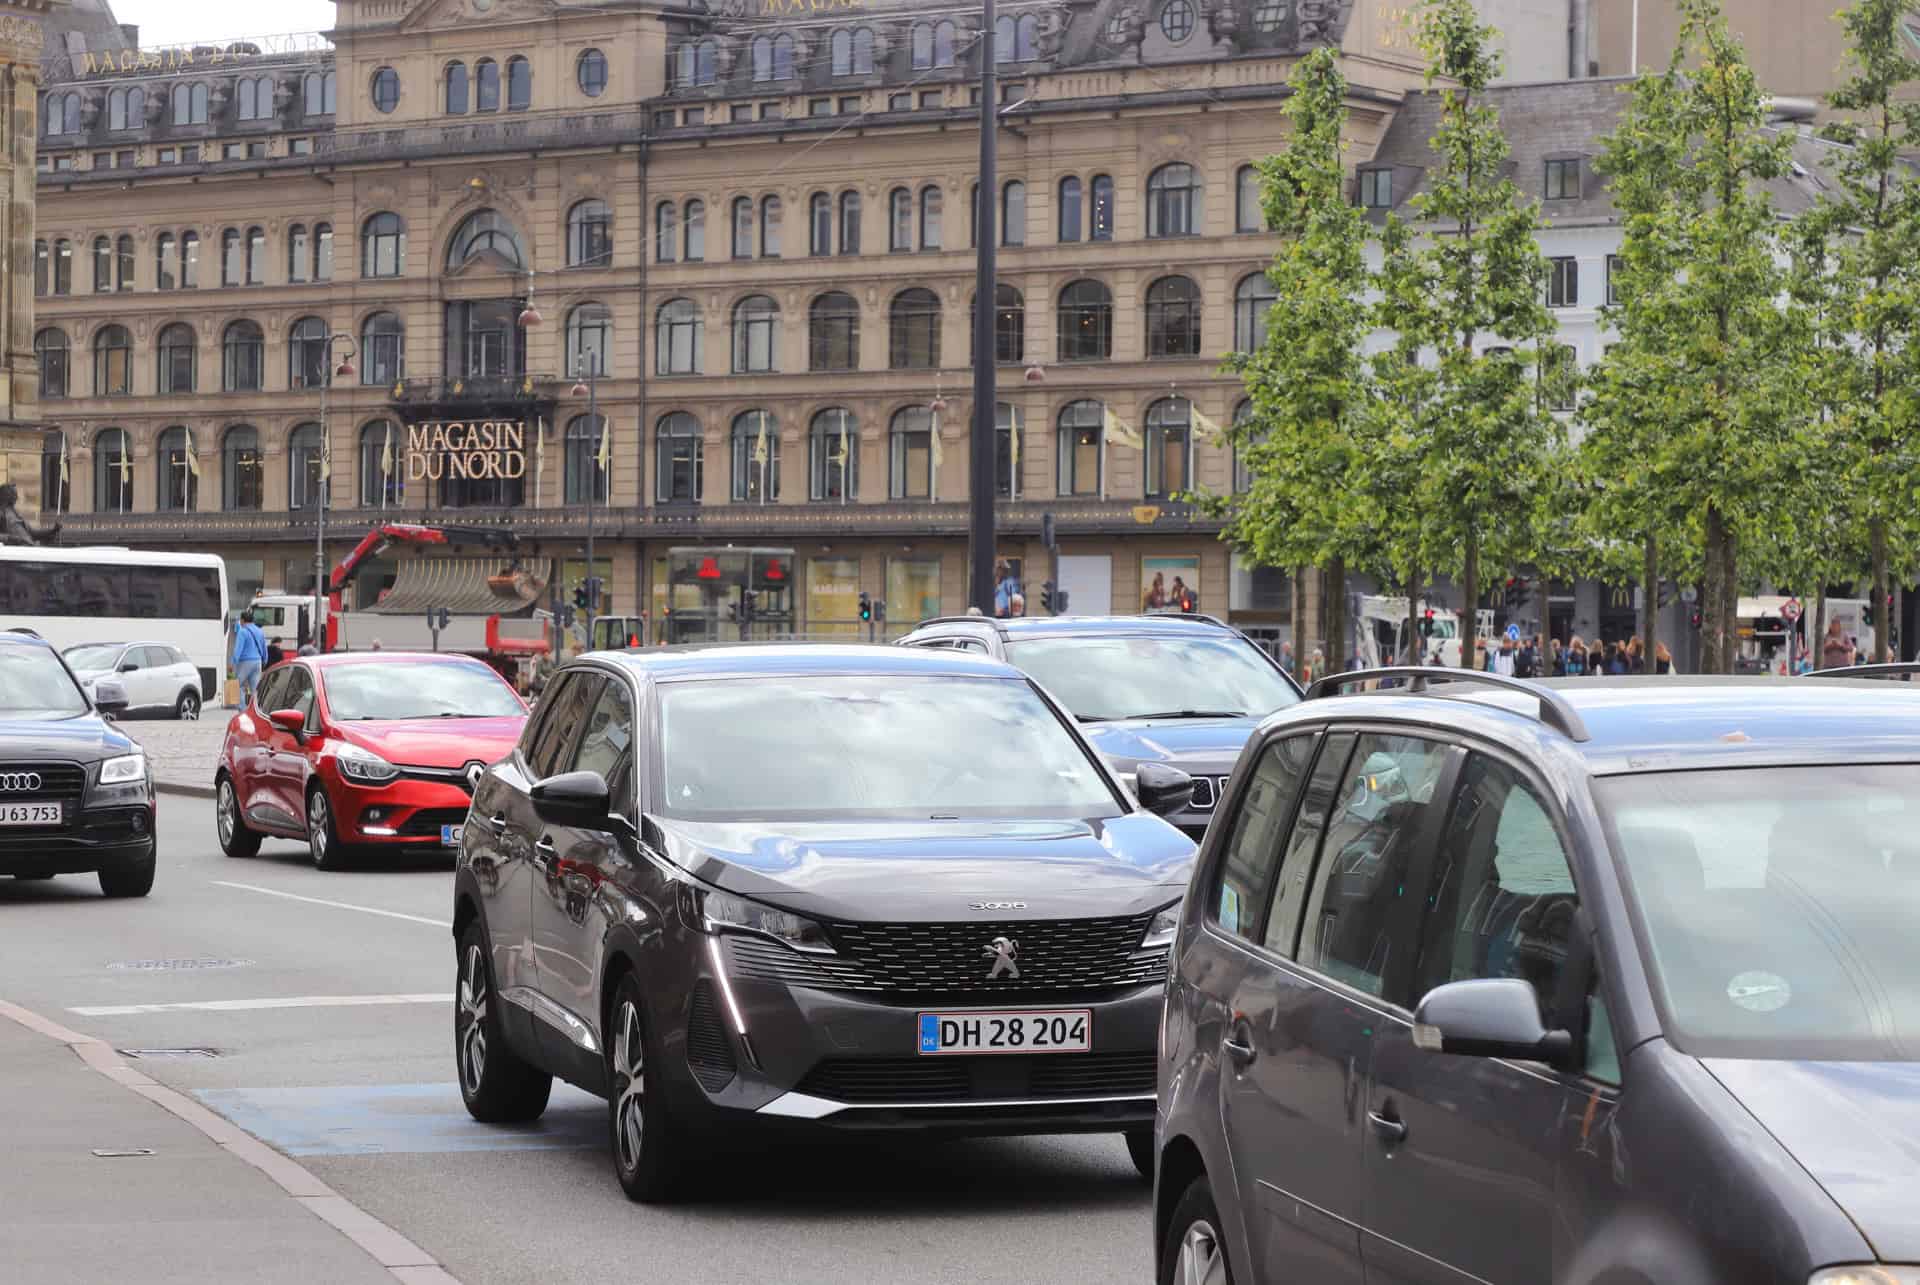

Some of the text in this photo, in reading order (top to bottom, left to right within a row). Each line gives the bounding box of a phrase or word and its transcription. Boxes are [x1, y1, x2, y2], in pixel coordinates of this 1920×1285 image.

[408, 422, 525, 451] MAGASIN
[409, 450, 525, 480] DU NORD
[10, 807, 28, 821] 63
[32, 806, 58, 821] 753
[941, 1017, 1086, 1047] DH 28 204
